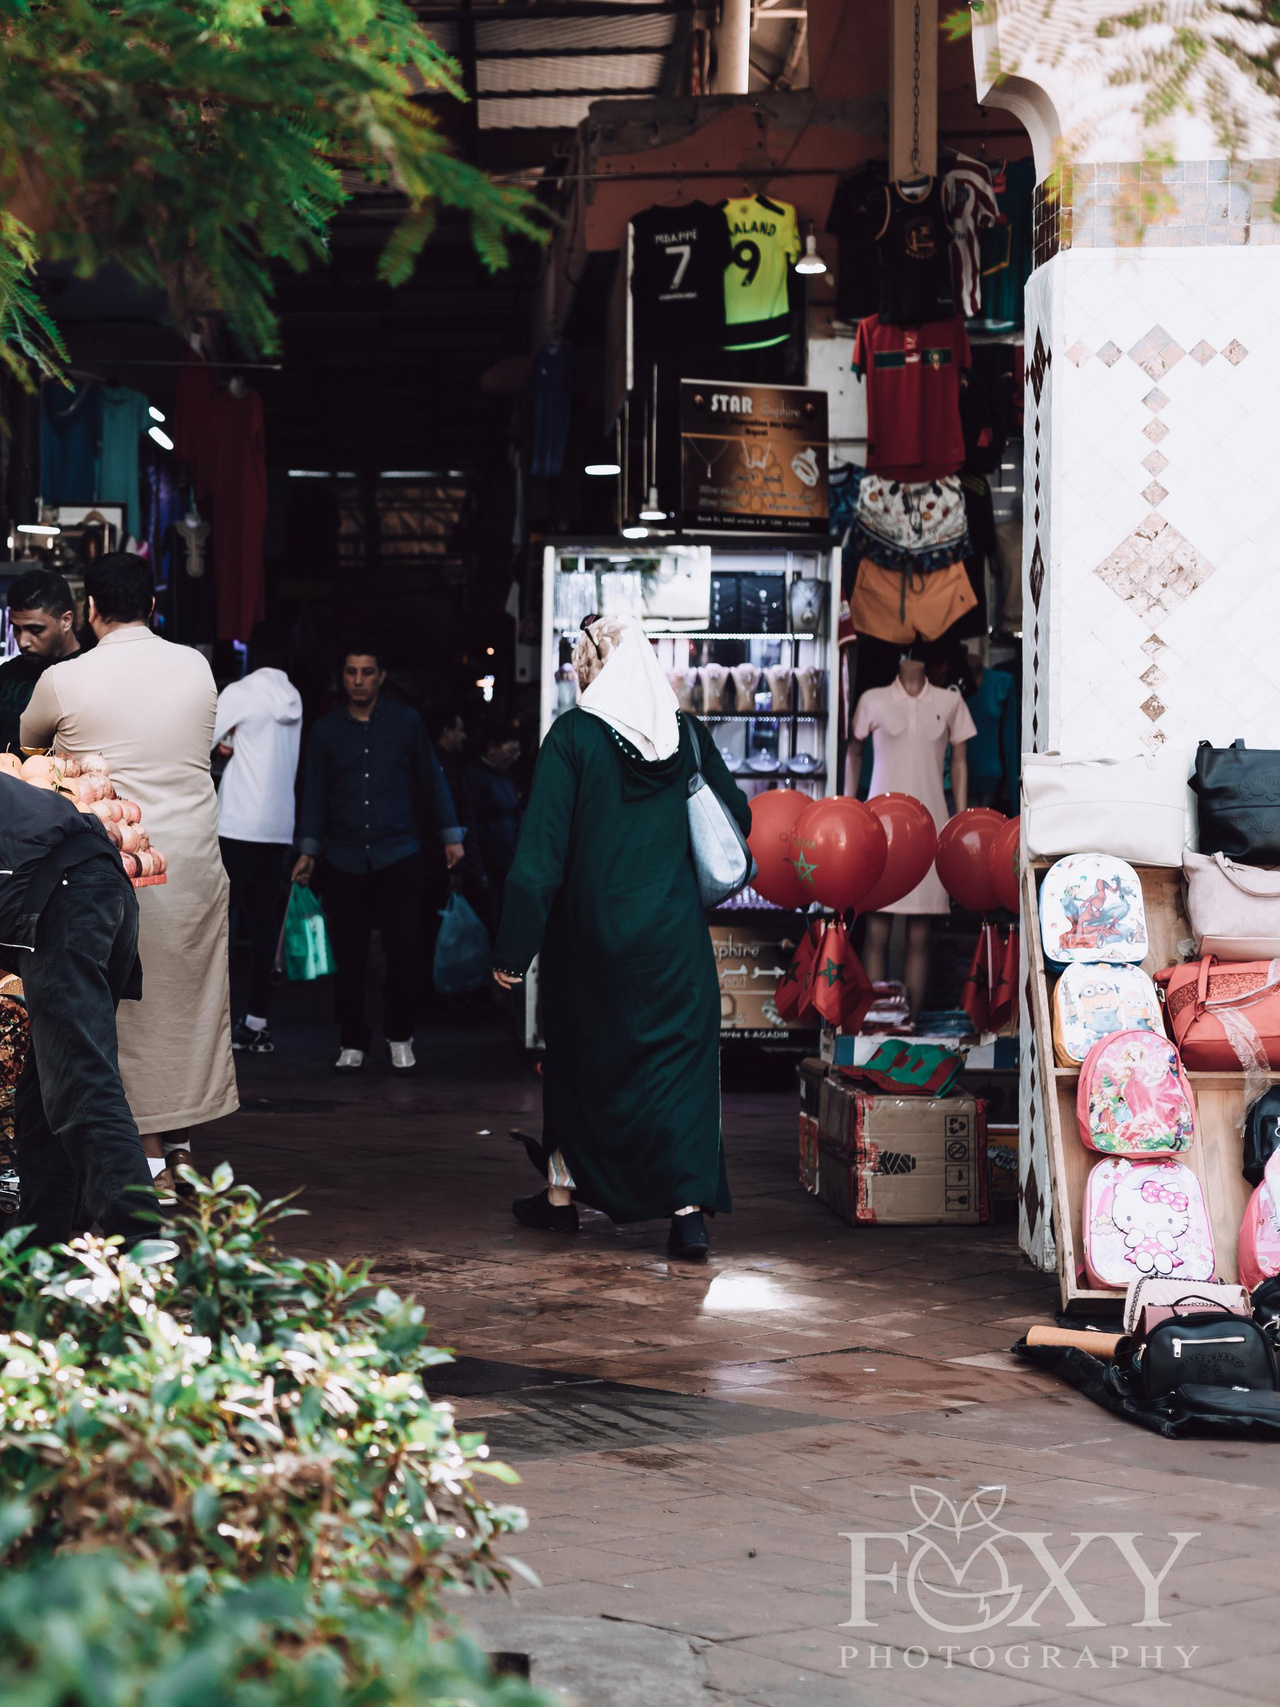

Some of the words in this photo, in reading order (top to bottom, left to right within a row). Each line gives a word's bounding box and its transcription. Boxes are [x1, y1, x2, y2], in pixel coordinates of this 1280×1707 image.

[730, 222, 777, 237] ALAND
[665, 245, 691, 290] 7
[733, 239, 761, 288] 9
[711, 393, 753, 414] STAR
[714, 934, 759, 961] phire
